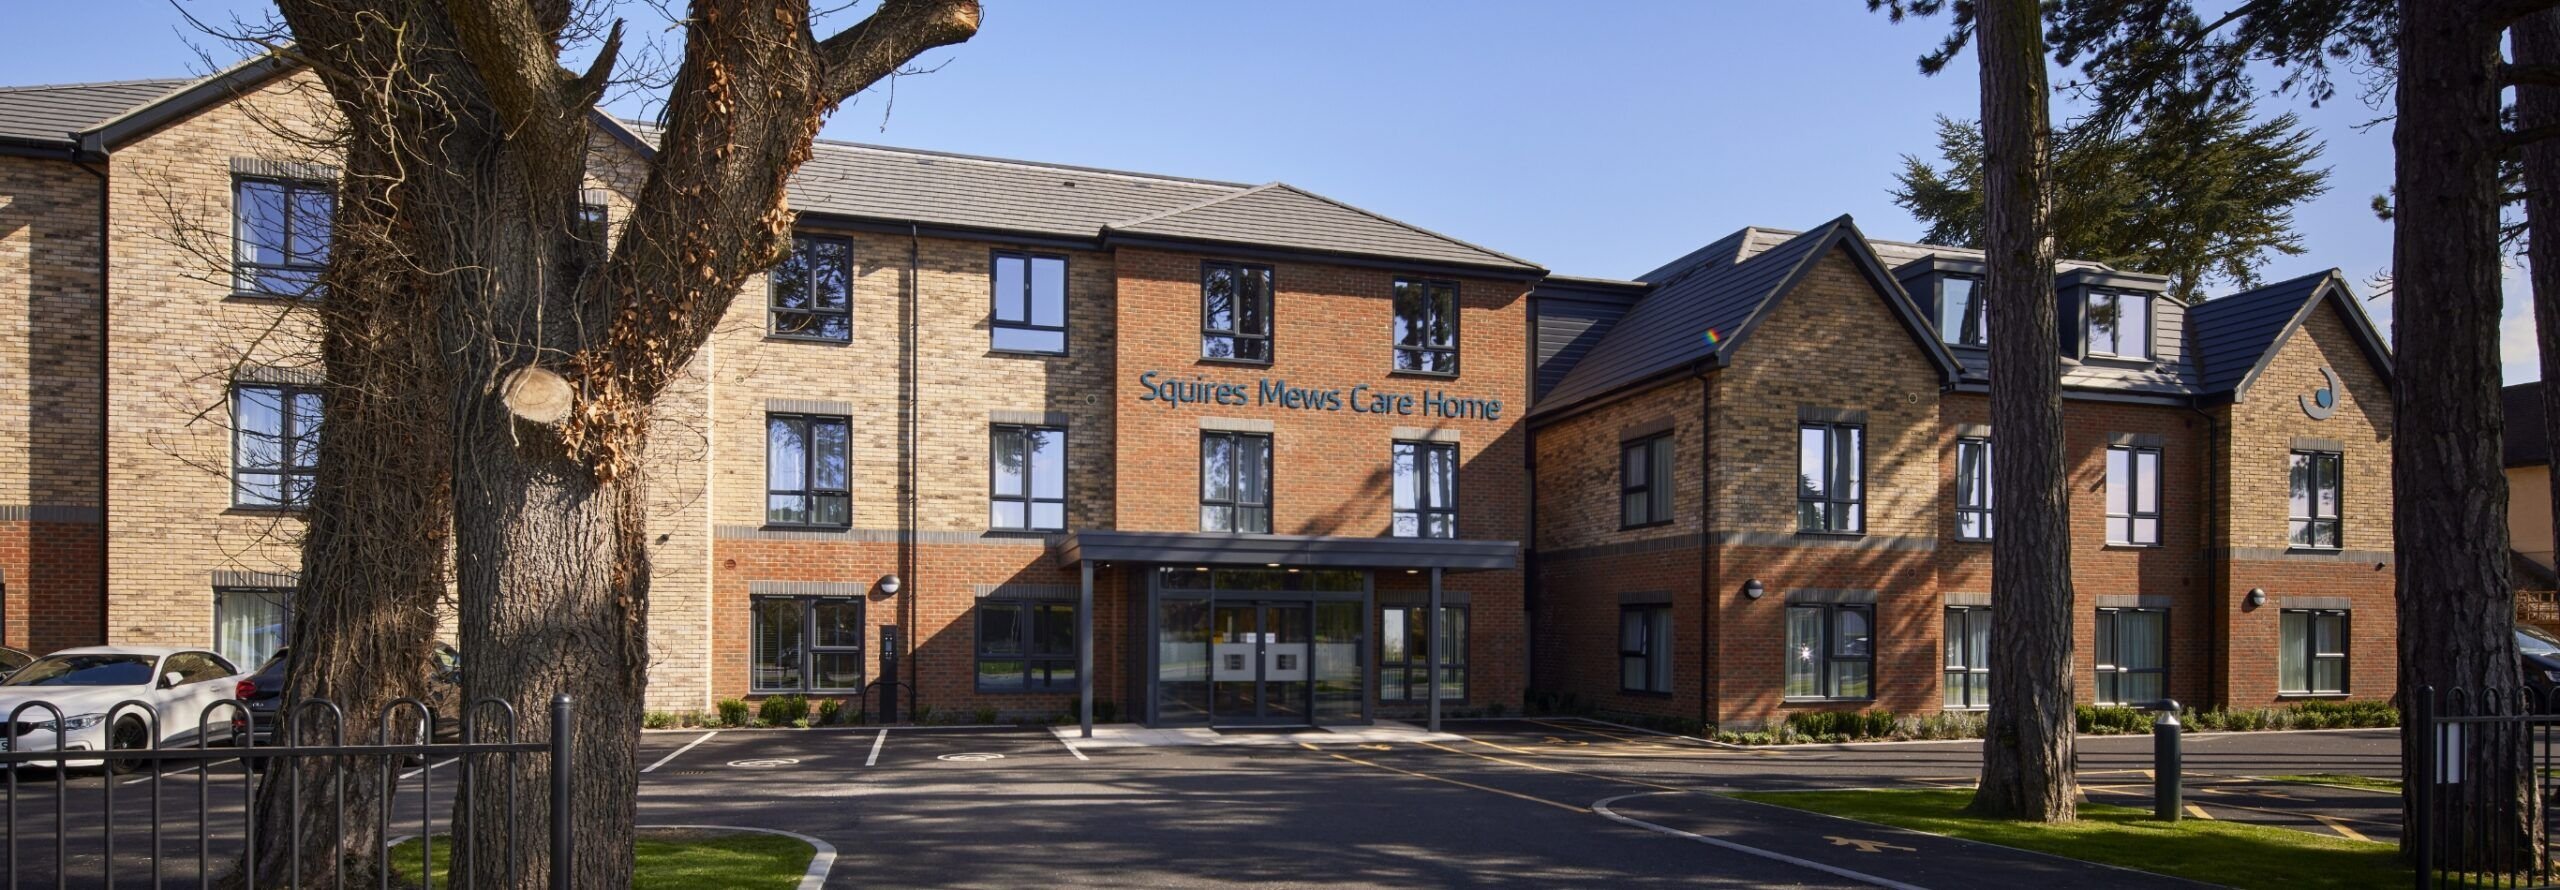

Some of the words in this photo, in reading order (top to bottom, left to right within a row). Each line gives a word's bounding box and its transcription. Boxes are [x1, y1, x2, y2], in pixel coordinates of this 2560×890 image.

[1140, 371, 1249, 408] Squires
[1258, 379, 1343, 411] Mews
[1351, 384, 1414, 415] Care
[1424, 389, 1503, 421] Home
